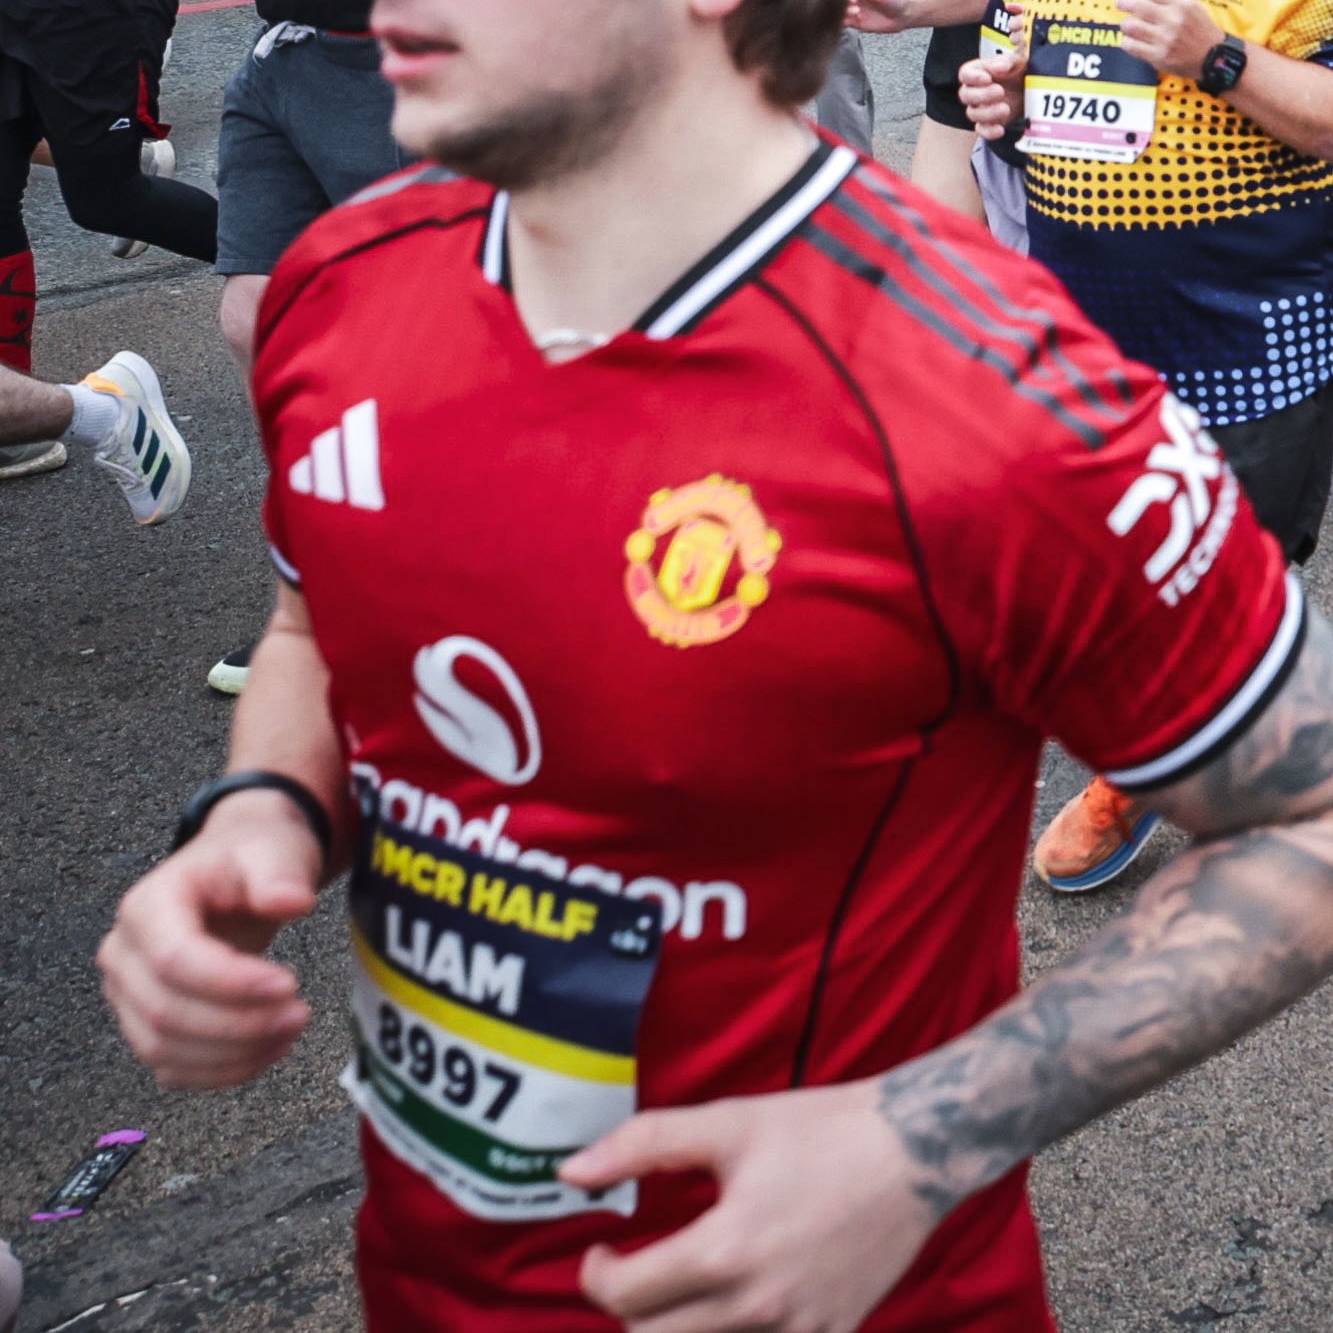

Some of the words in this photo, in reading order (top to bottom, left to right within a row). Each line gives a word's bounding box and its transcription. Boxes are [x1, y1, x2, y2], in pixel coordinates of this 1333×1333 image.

[1061, 26, 1093, 43] MCR
[1067, 51, 1102, 78] DC
[1043, 94, 1122, 124] 19740
[382, 835, 467, 908] MCR
[469, 873, 599, 942] HALF
[386, 904, 526, 1017] LIAM
[377, 1001, 527, 1124] 8997
